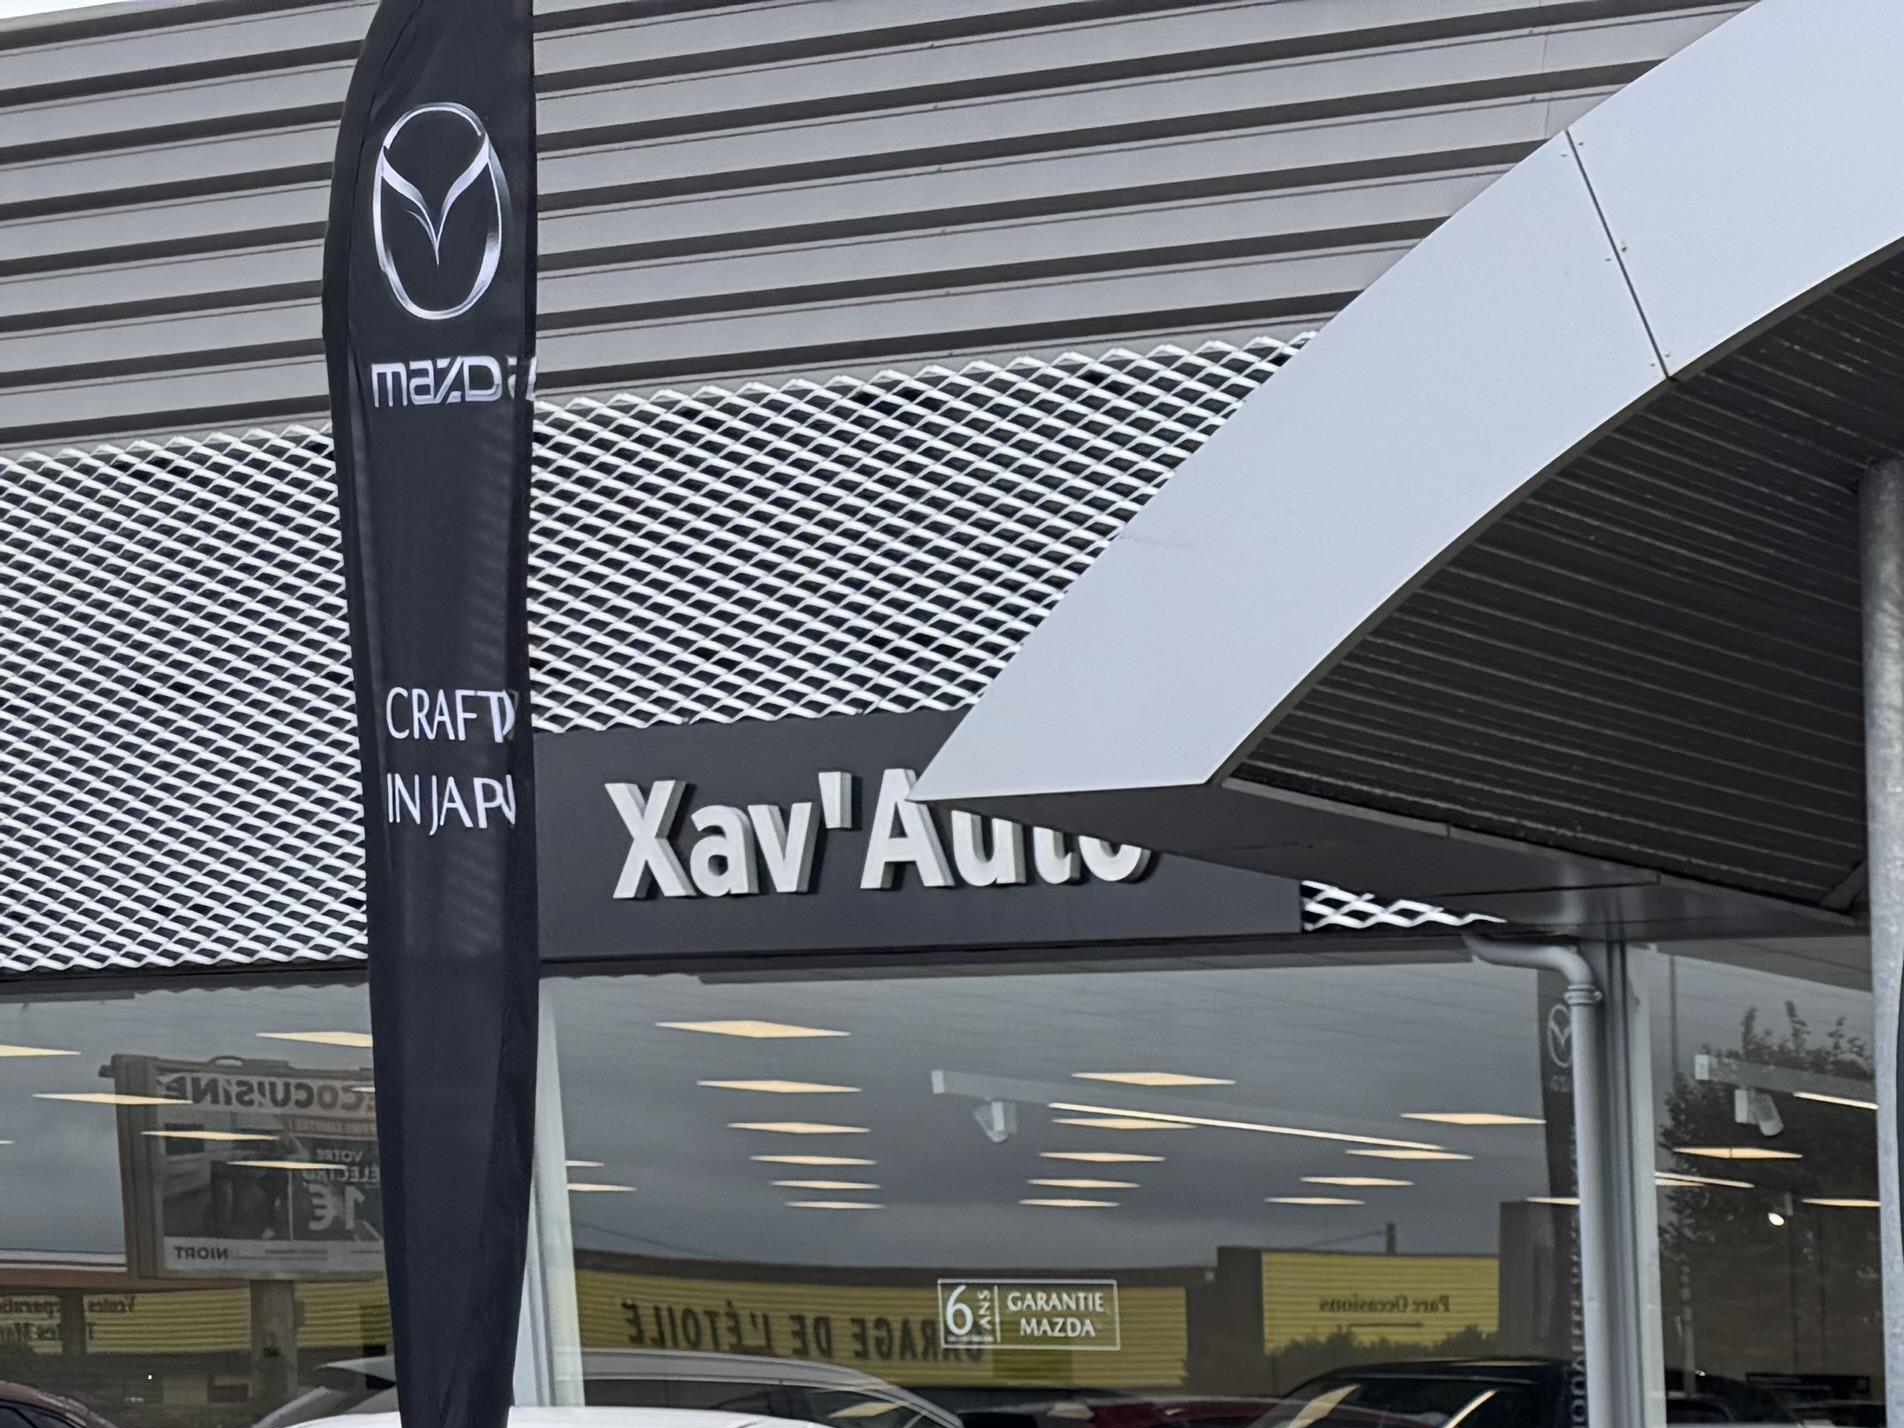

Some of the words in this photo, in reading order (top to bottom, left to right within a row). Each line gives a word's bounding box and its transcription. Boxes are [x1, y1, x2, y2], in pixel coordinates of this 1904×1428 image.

[386, 773, 421, 825] IN
[946, 1284, 974, 1336] 6
[978, 1289, 993, 1331] ANS
[1006, 1292, 1105, 1313] GARANTIE
[1019, 1317, 1096, 1338] MAZDA
